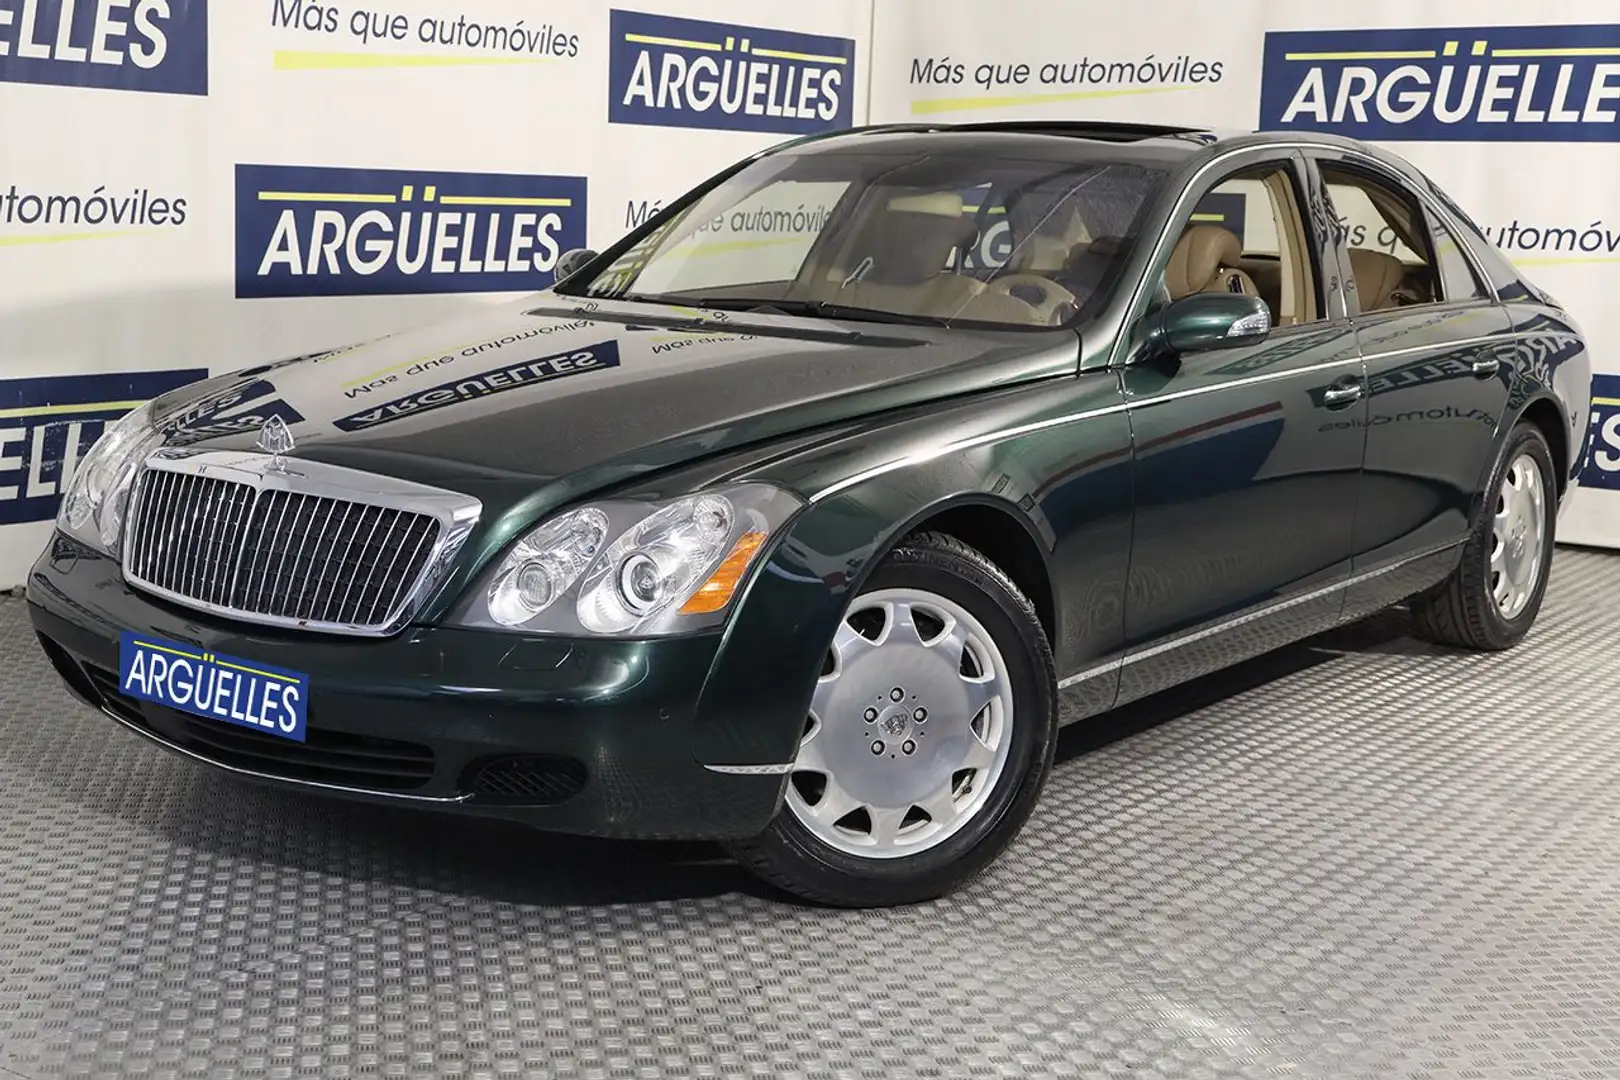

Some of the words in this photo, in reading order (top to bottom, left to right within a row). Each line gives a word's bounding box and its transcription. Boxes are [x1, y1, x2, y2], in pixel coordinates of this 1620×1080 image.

[271, 0, 339, 32] Más
[350, 9, 408, 44] que
[418, 15, 579, 57] automóviles
[623, 36, 843, 122] ARGÜELLES
[909, 57, 965, 84] Más
[974, 63, 1030, 90] que
[1039, 54, 1224, 84] automóviles
[1281, 41, 1620, 124] ARGÜELLE
[0, 185, 187, 226] tomóviles
[257, 185, 563, 277] ARGÜELLES
[125, 650, 299, 733] ARGÜELLES
